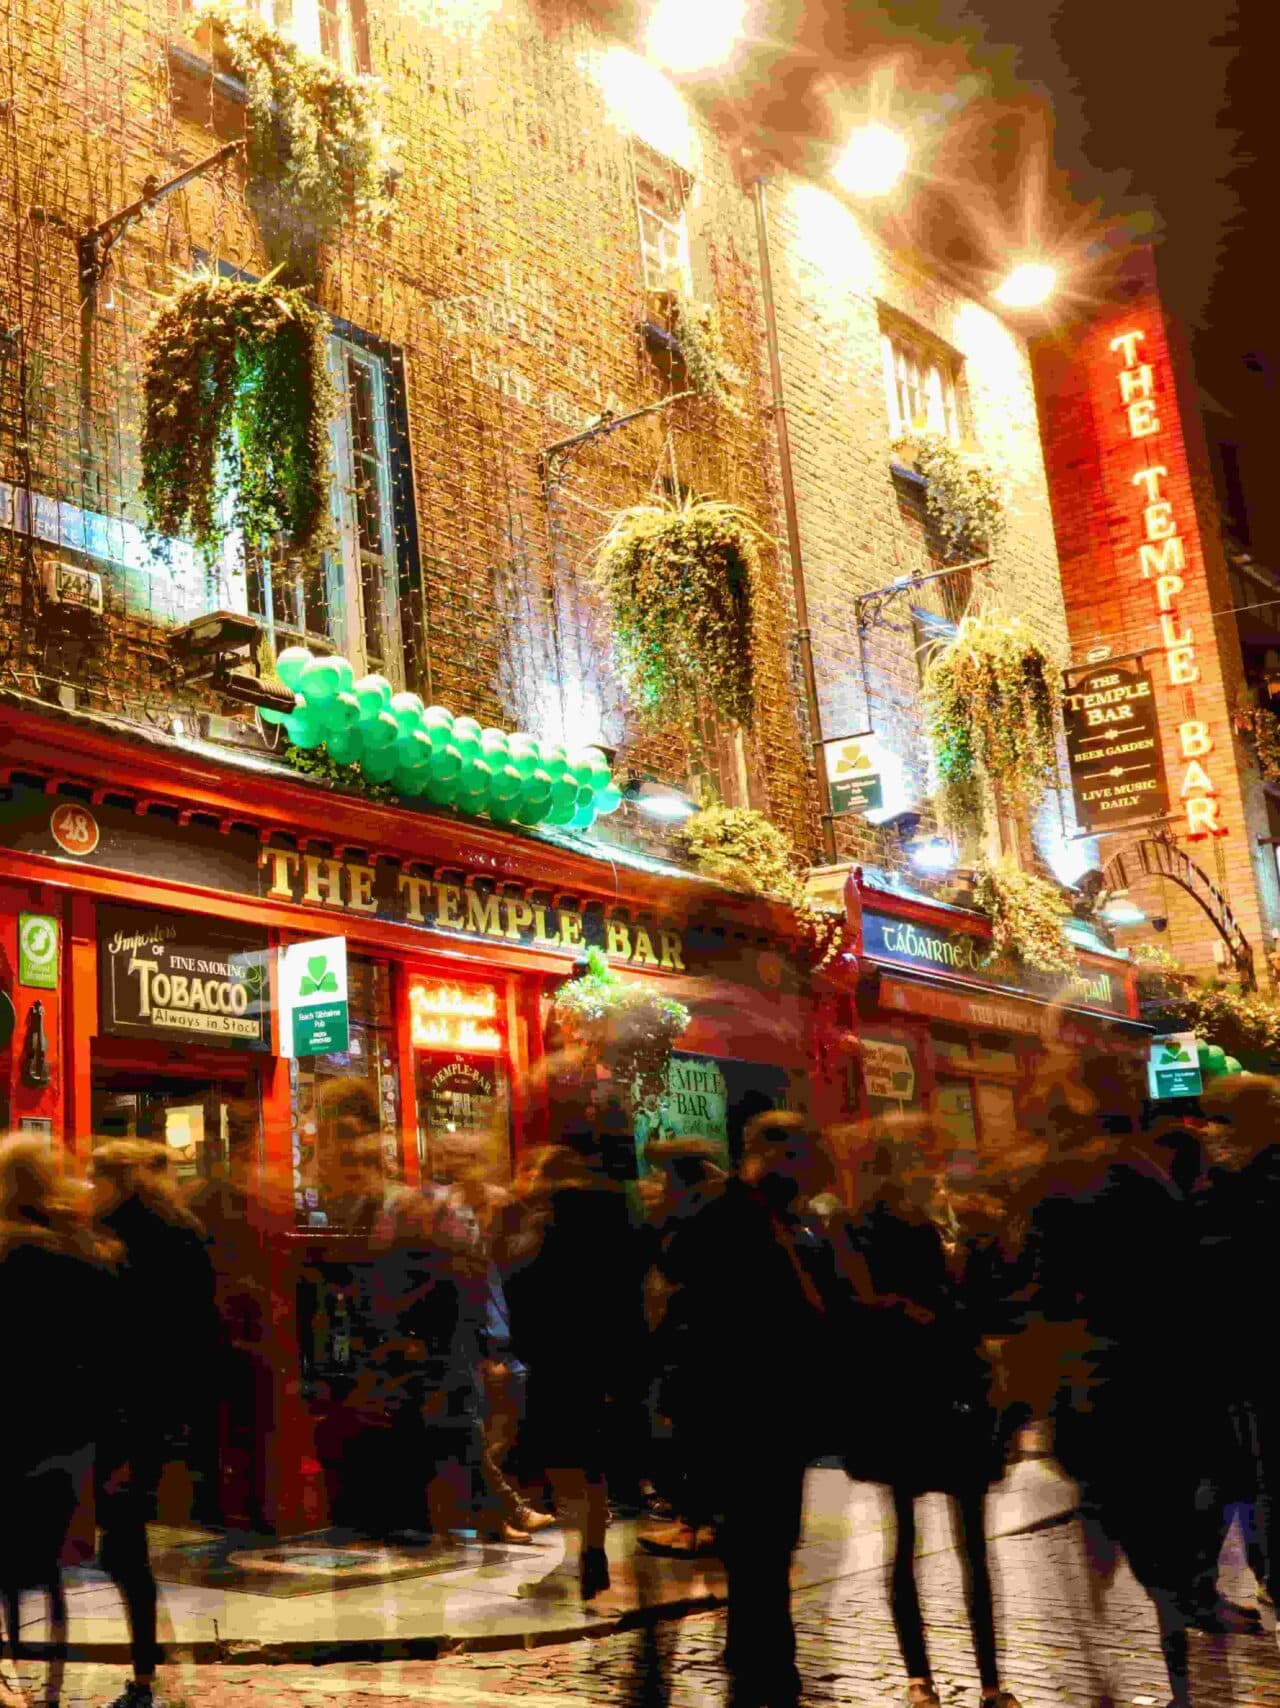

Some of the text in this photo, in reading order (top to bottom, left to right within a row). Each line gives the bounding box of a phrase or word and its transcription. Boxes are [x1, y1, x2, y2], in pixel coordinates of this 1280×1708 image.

[1109, 330, 1219, 834] THE TEMPLE BAR
[1090, 674, 1120, 689] THE
[1070, 682, 1151, 711] TEMPLE
[1086, 704, 1134, 726] BAR
[1074, 738, 1155, 763] BEER GARDEN
[1081, 779, 1157, 801] LIVE MUSIC
[1100, 795, 1140, 811] DAILY
[59, 811, 89, 843] 48
[263, 848, 686, 970] THE TEMPLE BAR
[108, 924, 177, 959] Importers
[152, 944, 165, 957] OF
[170, 955, 246, 979] FINE SMOKING
[128, 958, 248, 1017] TOBACCO
[154, 1009, 258, 1034] Always in Stock
[432, 1063, 470, 1088] TEMPLE
[675, 1092, 712, 1121] BAR
